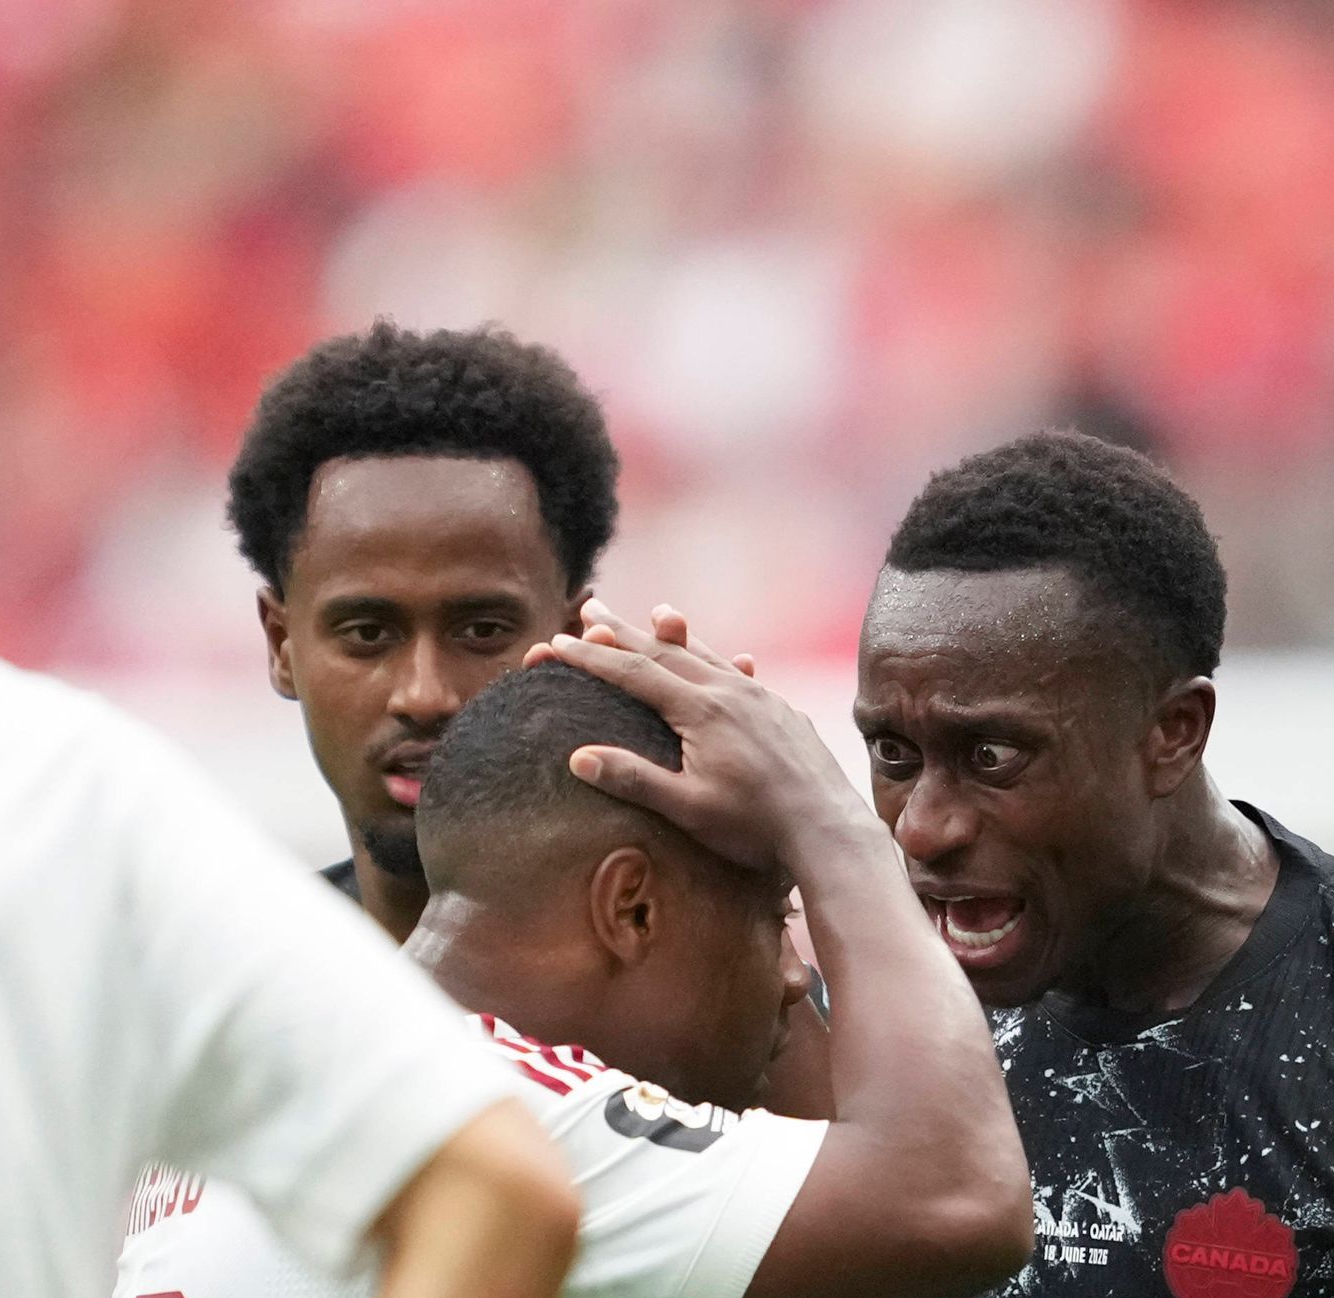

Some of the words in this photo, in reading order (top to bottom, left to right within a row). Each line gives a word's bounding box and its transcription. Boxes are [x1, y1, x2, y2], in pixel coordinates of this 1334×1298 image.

[1090, 1223, 1124, 1242] QATAR
[1044, 1245, 1057, 1261] 18
[1060, 1246, 1086, 1263] JUNE
[1088, 1248, 1108, 1265] 2026
[1170, 1243, 1287, 1277] CANADA
